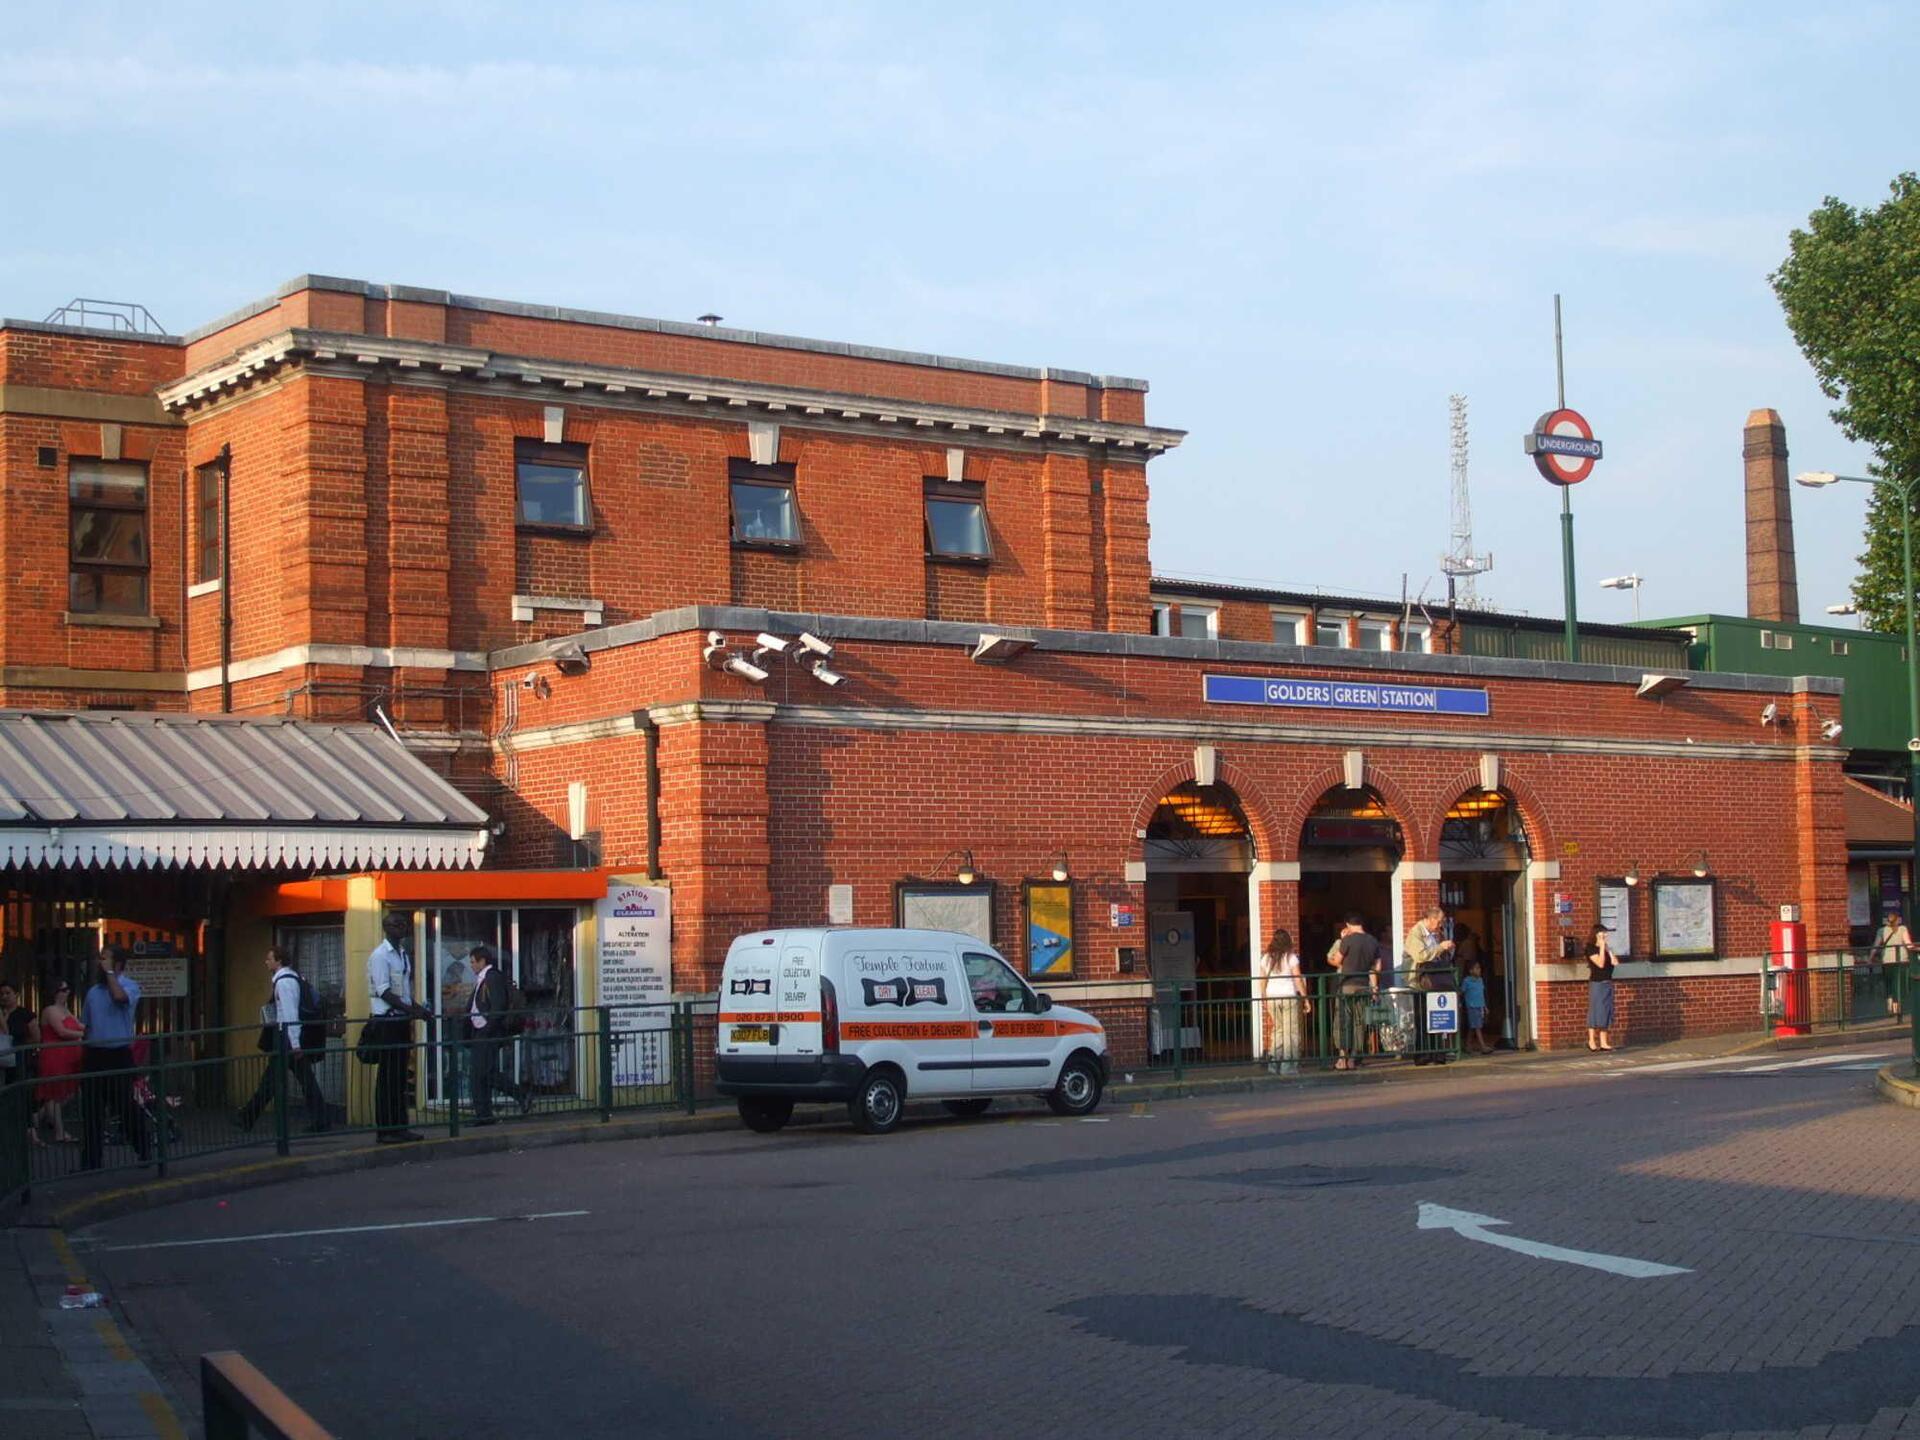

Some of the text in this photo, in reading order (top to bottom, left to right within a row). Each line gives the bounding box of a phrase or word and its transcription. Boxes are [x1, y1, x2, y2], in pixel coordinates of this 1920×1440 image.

[1537, 436, 1600, 455] UNDERGROUND
[1268, 685, 1434, 707] GOLDERS GREEN STATION
[617, 889, 648, 902] STATION
[853, 955, 947, 976] Temple Fortune
[783, 968, 811, 978] COLLECTION
[784, 992, 807, 1002] DELIVERY
[878, 985, 937, 998] DRY CLEAN
[736, 1013, 752, 1022] 020
[848, 1023, 966, 1037] FREE COLLECTION & DELIVERY
